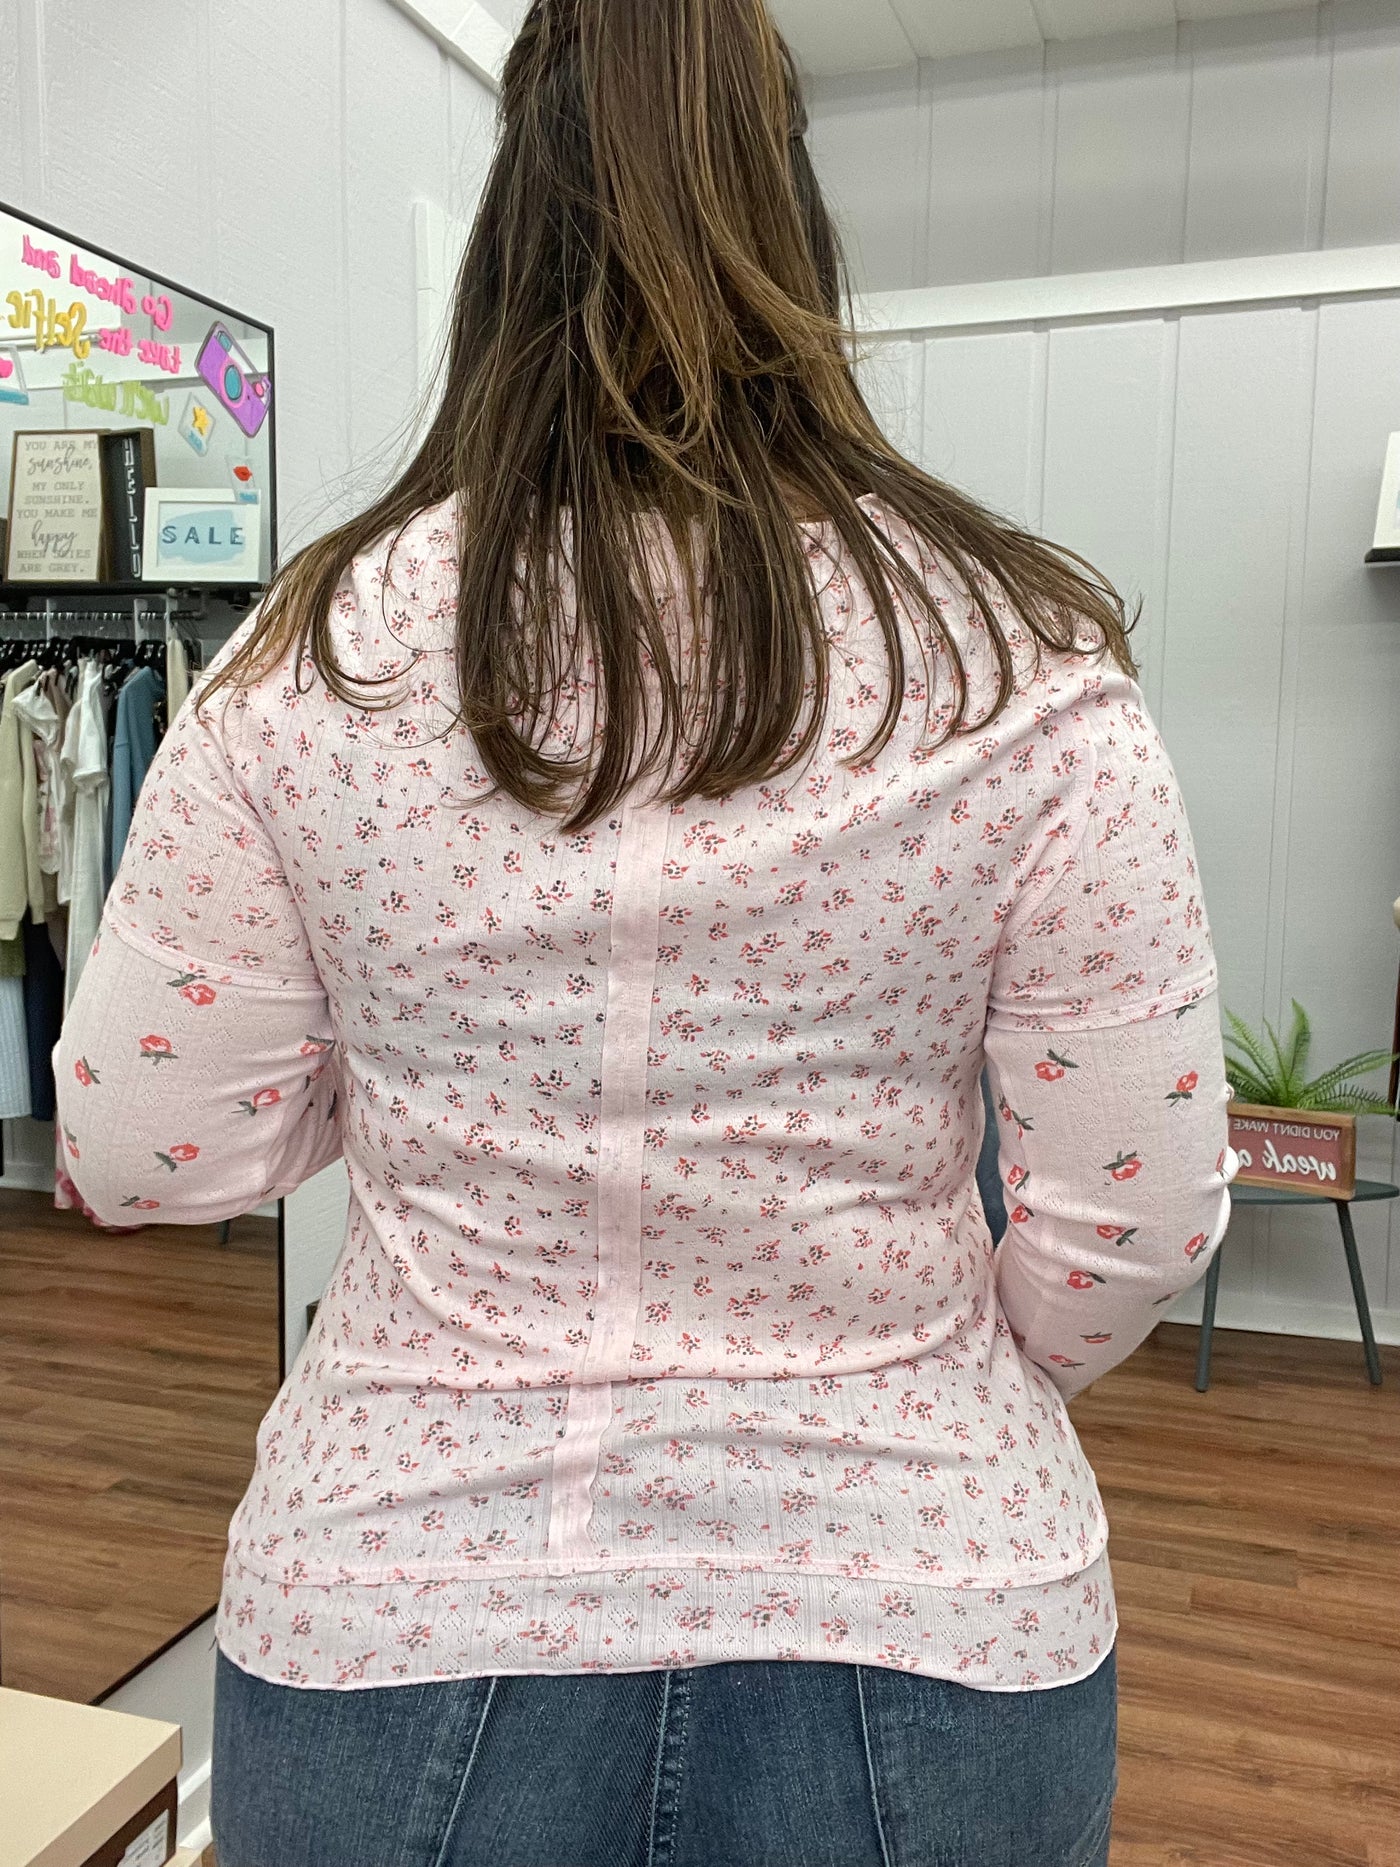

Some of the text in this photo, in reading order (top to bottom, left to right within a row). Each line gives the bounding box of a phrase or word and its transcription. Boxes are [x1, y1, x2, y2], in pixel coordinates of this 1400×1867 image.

[25, 441, 46, 451] YOU
[54, 441, 76, 450] ARE
[32, 481, 85, 491] MY ONLY
[16, 508, 98, 519] YOU MAKE ME
[31, 520, 78, 557] happy
[162, 525, 243, 545] SALE
[17, 550, 46, 559] WHEN
[18, 563, 42, 573] ARE
